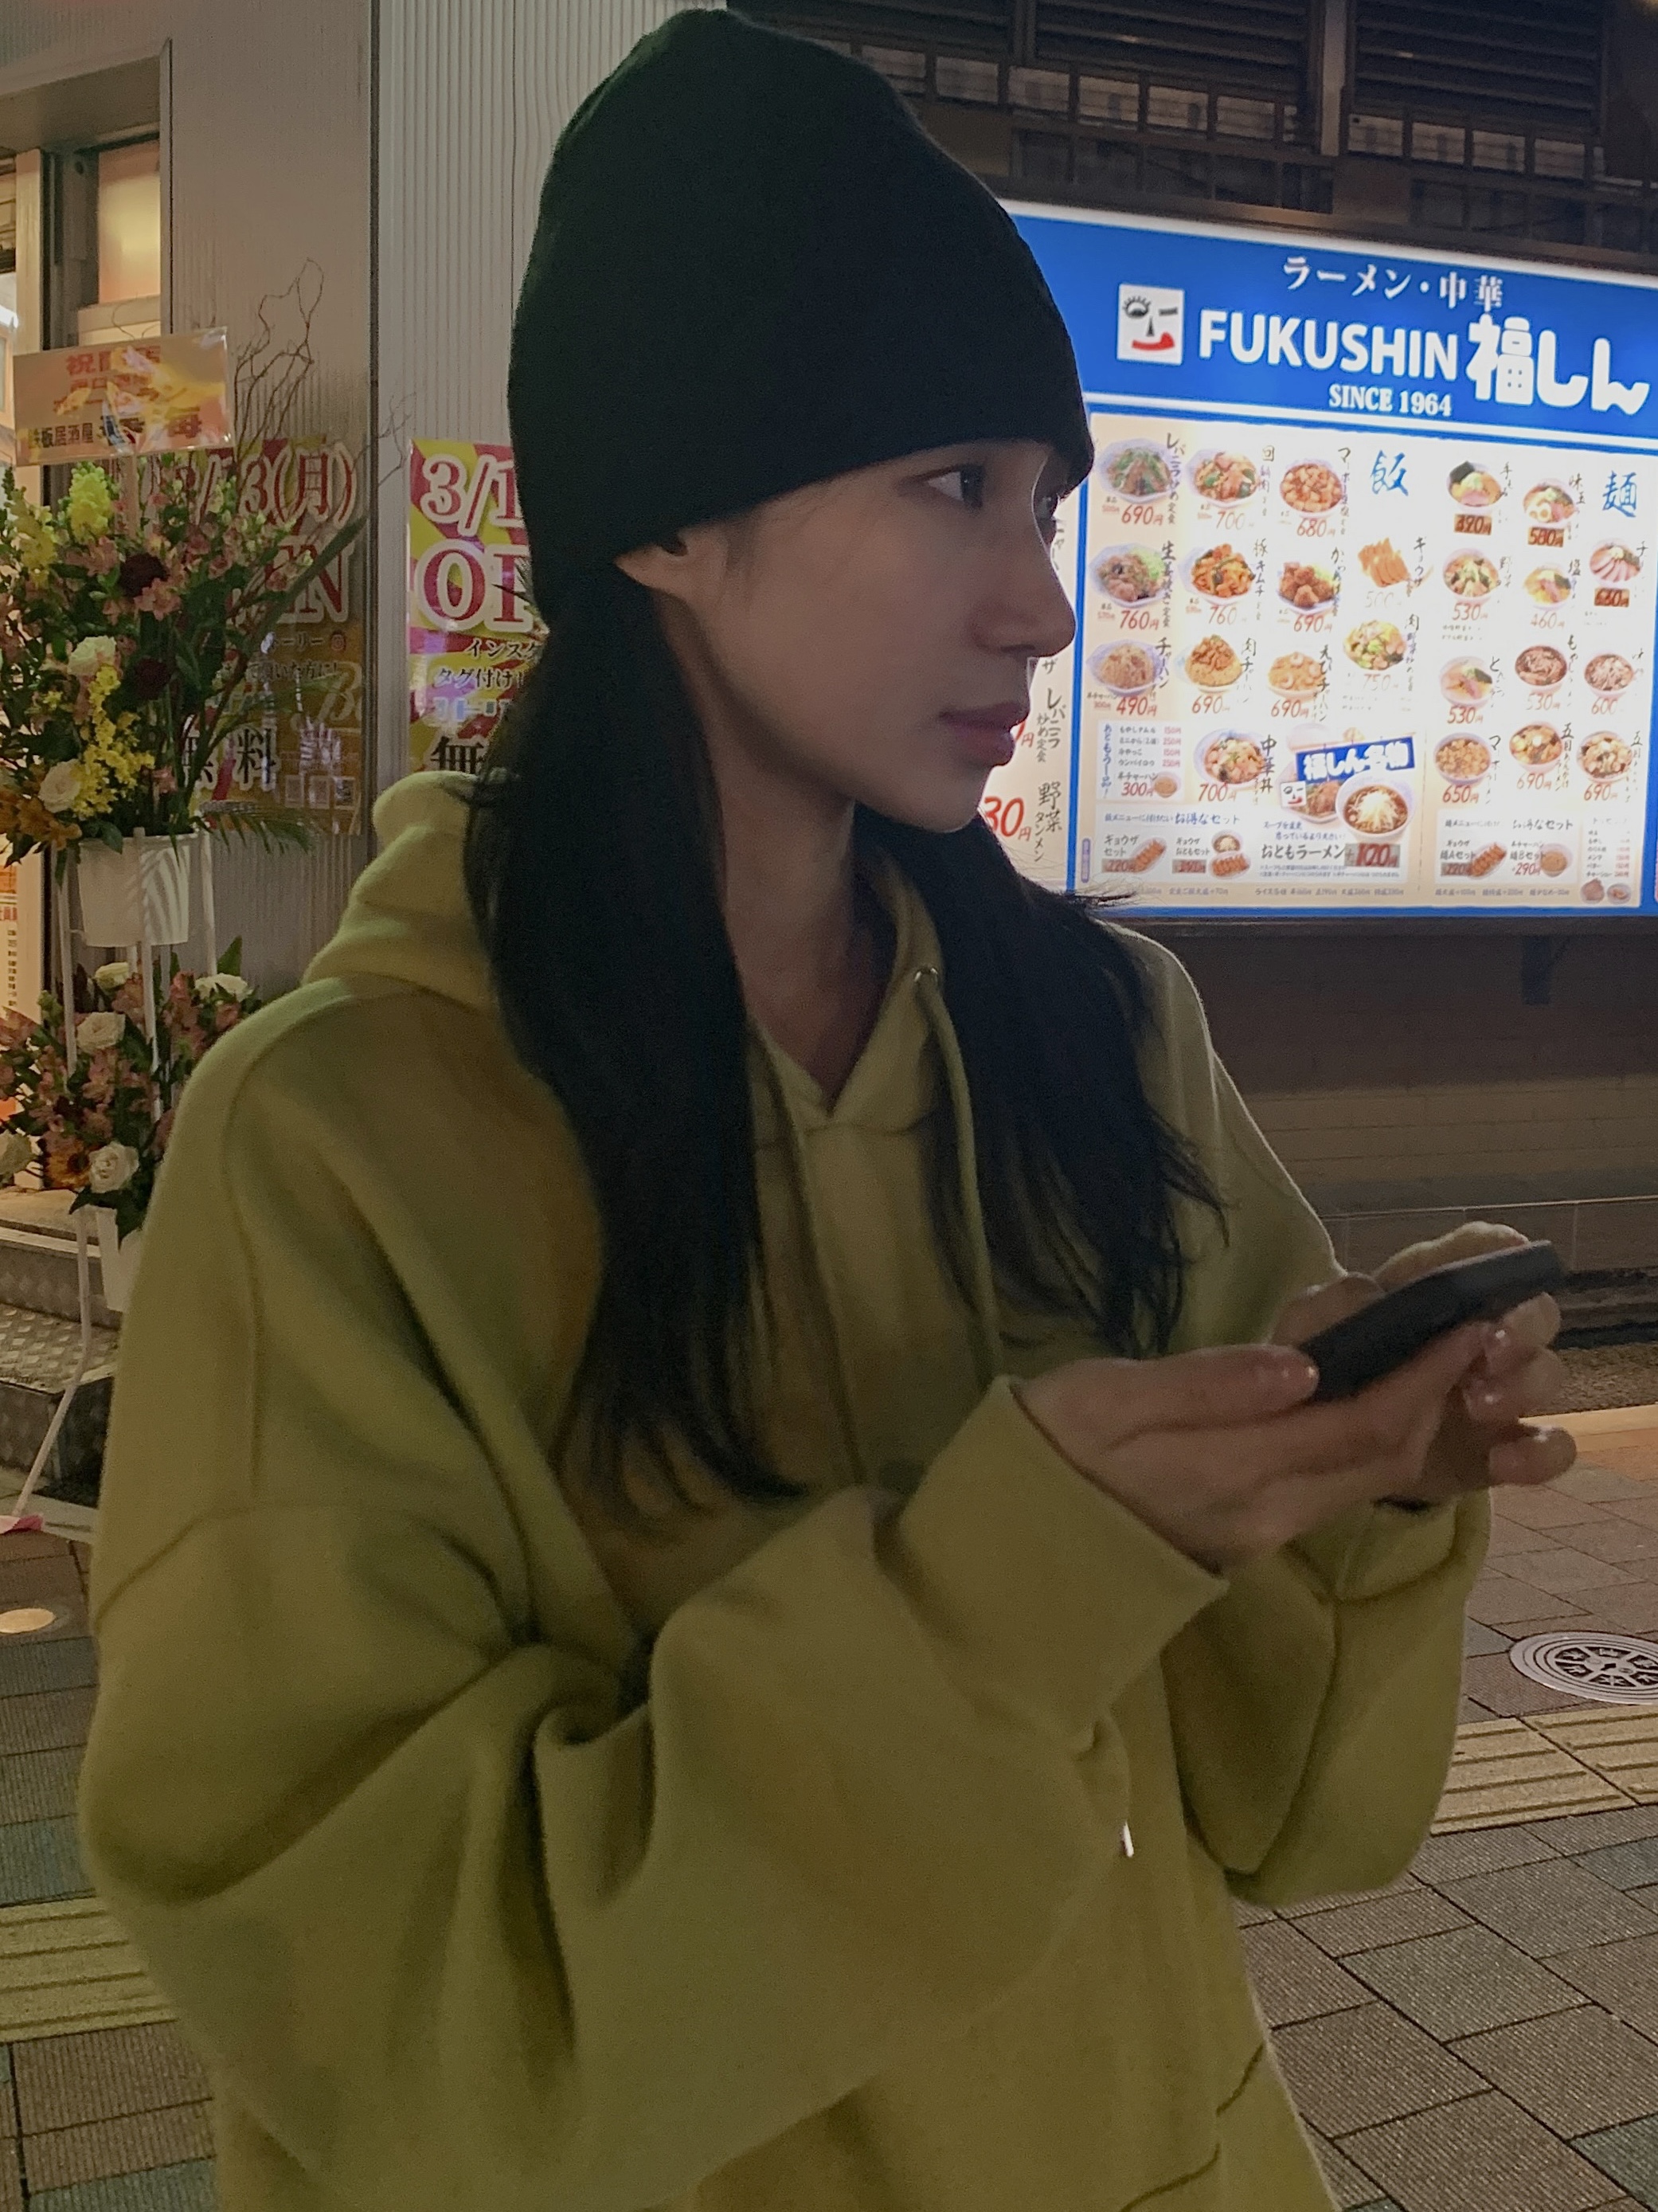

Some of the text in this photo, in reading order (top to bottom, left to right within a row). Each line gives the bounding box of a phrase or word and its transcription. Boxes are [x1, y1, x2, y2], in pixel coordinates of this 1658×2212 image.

[1283, 256, 1504, 312] ラーメン・中華
[1199, 308, 1651, 415] FUKUSHIN 福しん
[1329, 383, 1453, 417] SINCE 1964
[1601, 469, 1637, 518] 麺
[1119, 609, 1159, 631] 760円
[1116, 696, 1157, 717] 490円
[1038, 781, 1062, 833] 野菜
[1261, 843, 1347, 860] おともラーメン
